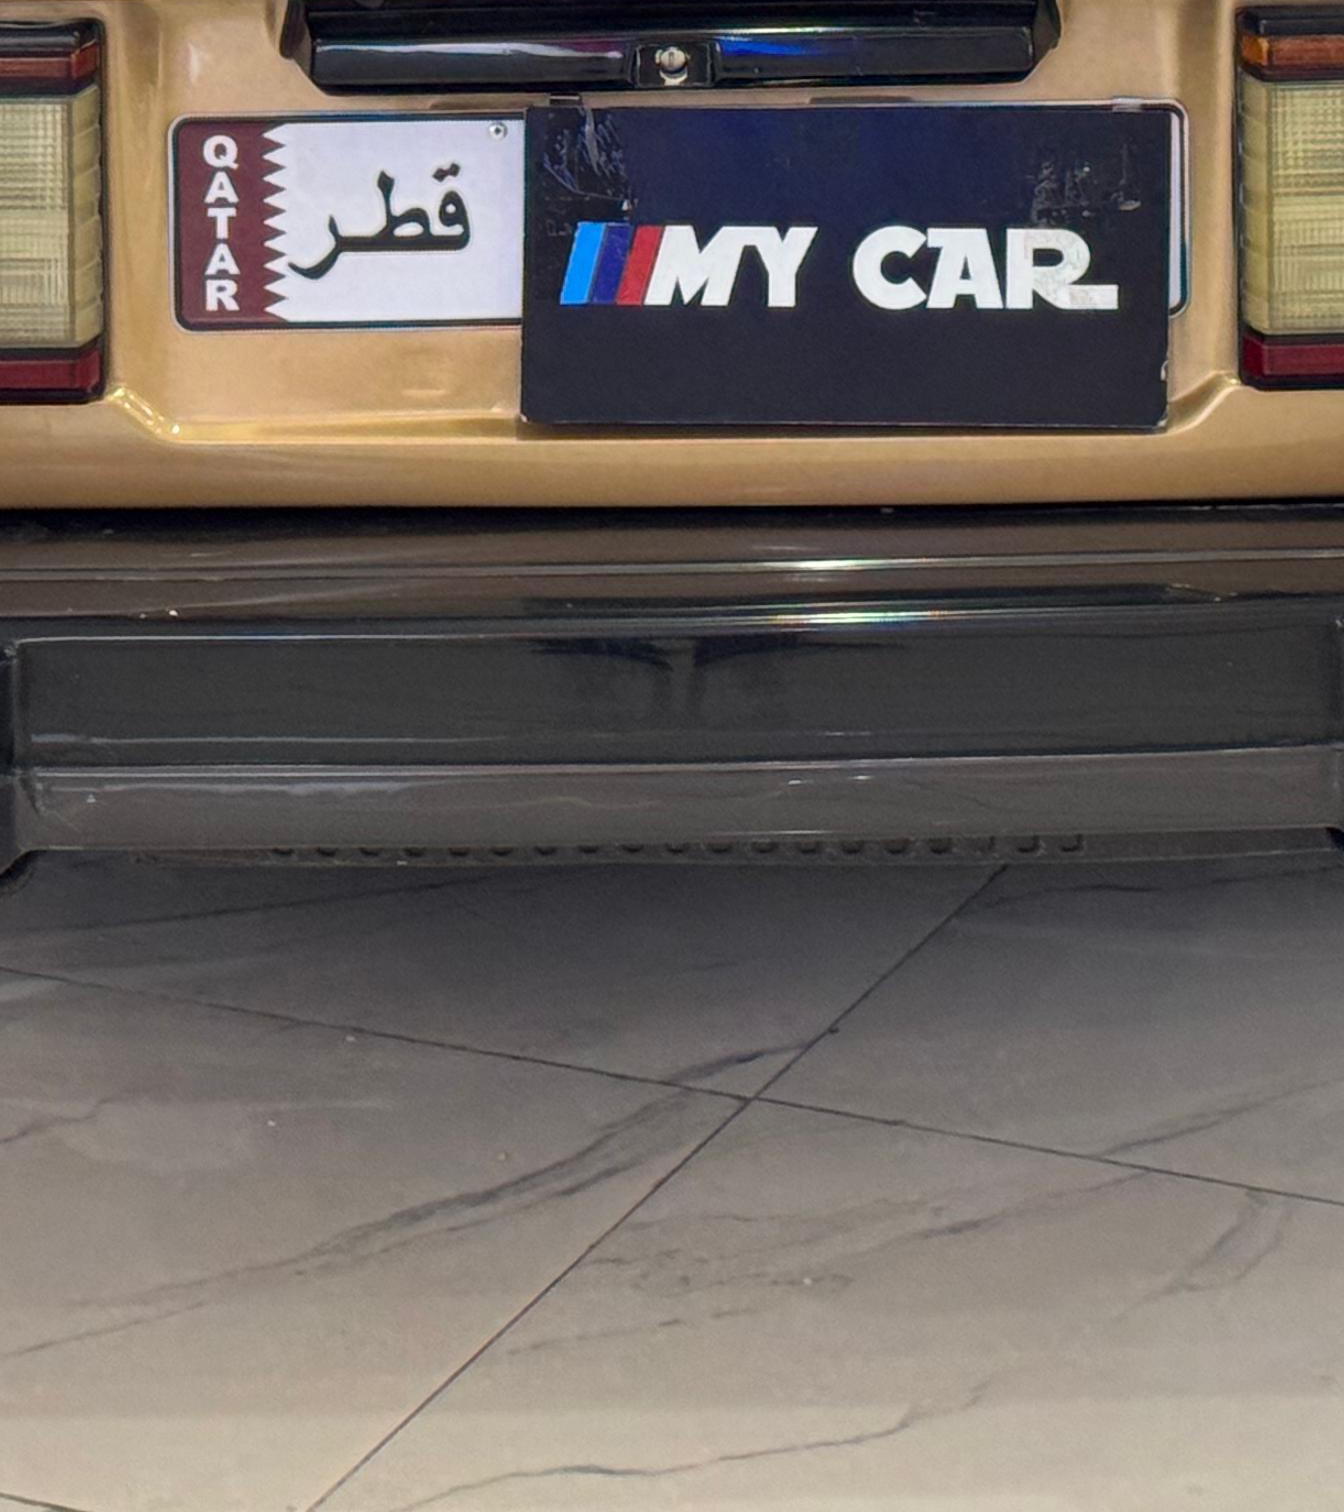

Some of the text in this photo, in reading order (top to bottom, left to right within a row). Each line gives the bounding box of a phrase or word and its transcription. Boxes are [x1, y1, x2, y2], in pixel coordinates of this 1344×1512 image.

[201, 134, 240, 313] QATAR
[289, 161, 472, 279] قطر
[644, 225, 1119, 311] MY CAR
